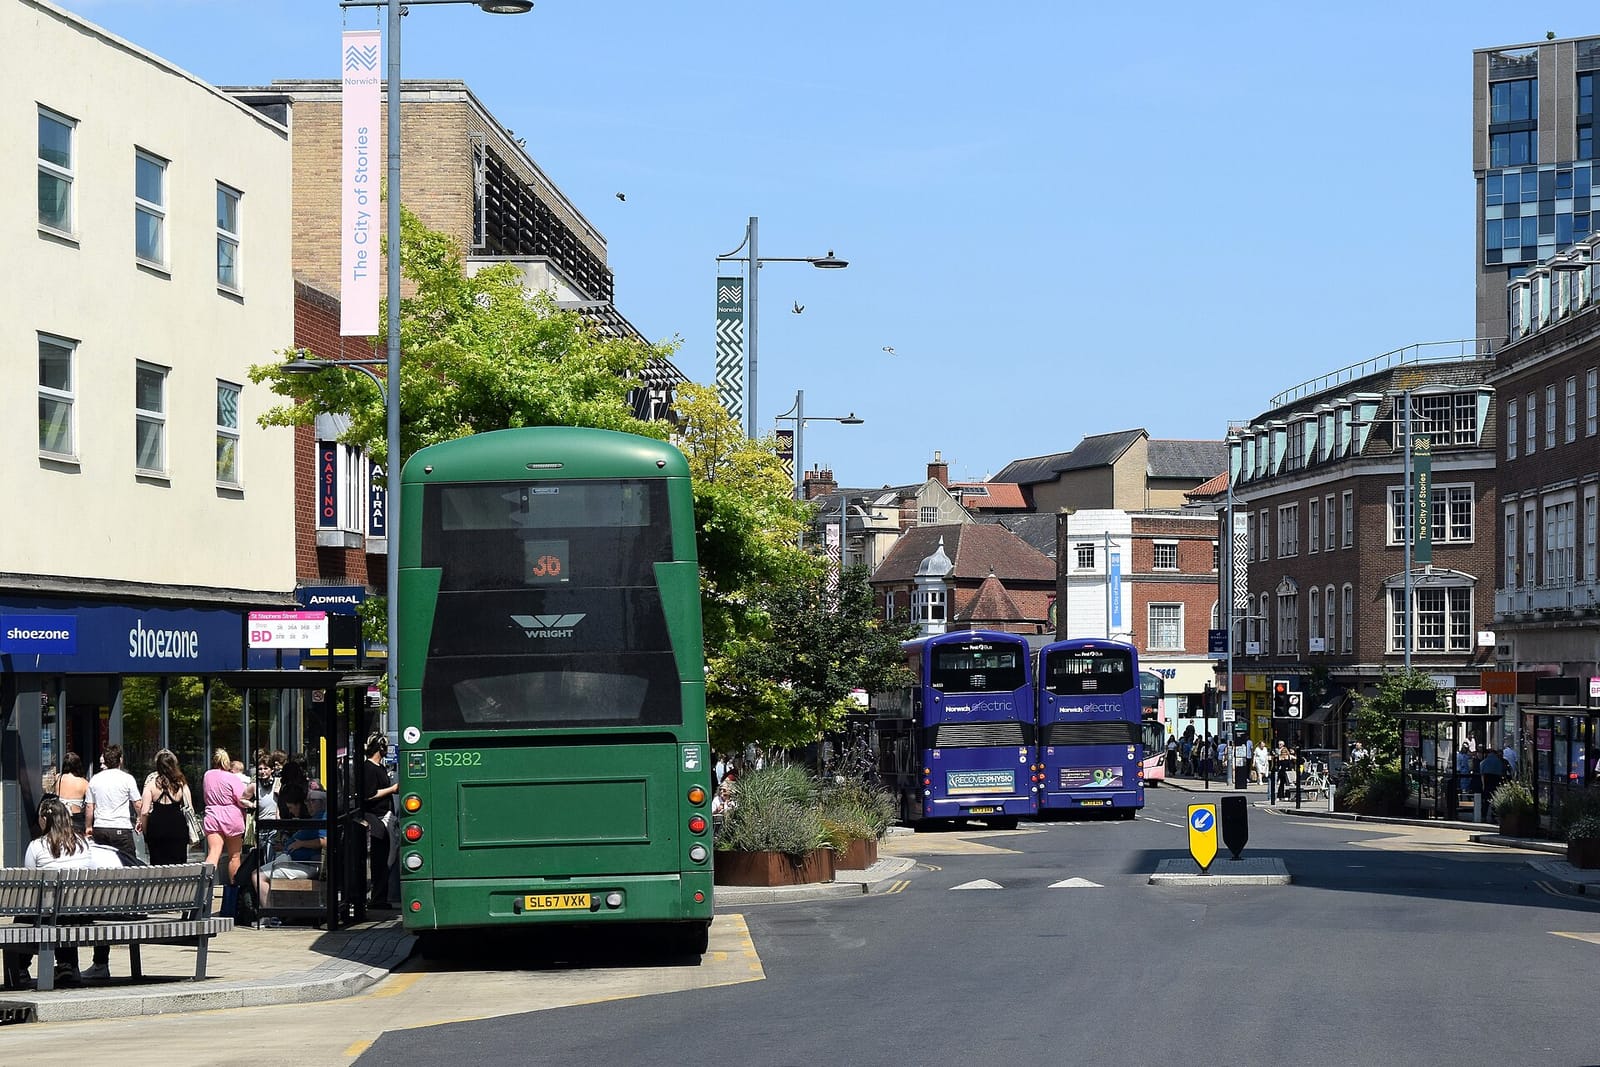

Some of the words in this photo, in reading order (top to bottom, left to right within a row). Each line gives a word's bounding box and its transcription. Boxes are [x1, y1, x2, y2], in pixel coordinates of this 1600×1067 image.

[344, 77, 378, 86] Norwich
[354, 127, 367, 184] Stories
[354, 189, 367, 205] of
[354, 211, 371, 245] City
[354, 250, 367, 281] The
[324, 451, 334, 518] CASINO
[1419, 499, 1426, 508] of
[1420, 508, 1428, 524] City
[310, 595, 360, 604] ADMIRAL
[7, 627, 70, 640] shoezone
[129, 619, 198, 659] shoezone
[251, 630, 272, 642] BD
[524, 630, 574, 638] WRIGHT
[945, 705, 970, 713] Norwich
[971, 700, 1012, 713] electric
[1083, 703, 1121, 713] electric
[434, 752, 482, 767] 35282
[955, 775, 1013, 784] RECOVERPHYSIO
[530, 896, 560, 907] SL67
[563, 895, 586, 906] VXK
